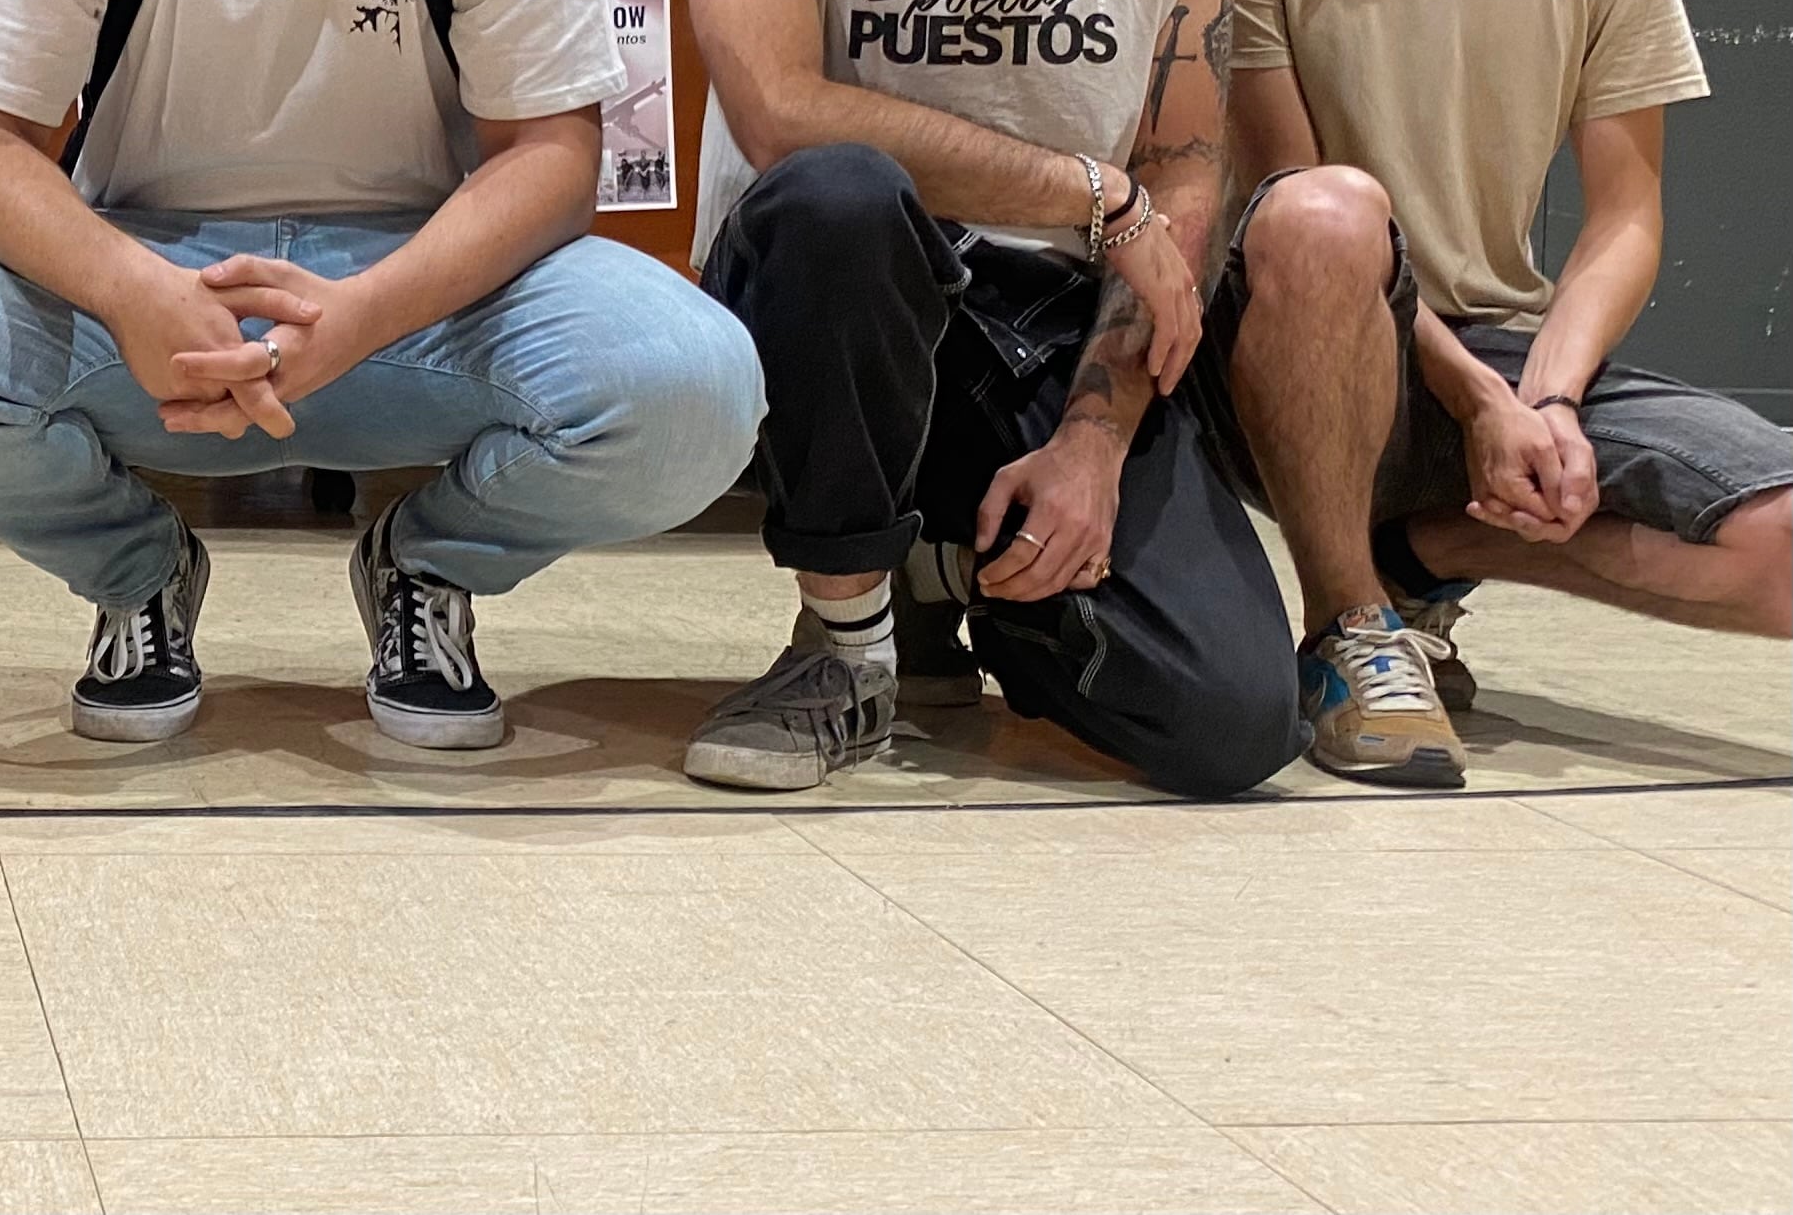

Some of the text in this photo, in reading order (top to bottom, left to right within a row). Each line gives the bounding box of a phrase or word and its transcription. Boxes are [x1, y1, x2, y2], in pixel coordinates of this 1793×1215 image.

[613, 5, 645, 29] OW
[616, 34, 647, 45] ntos
[848, 9, 1119, 67] PUESTOS
